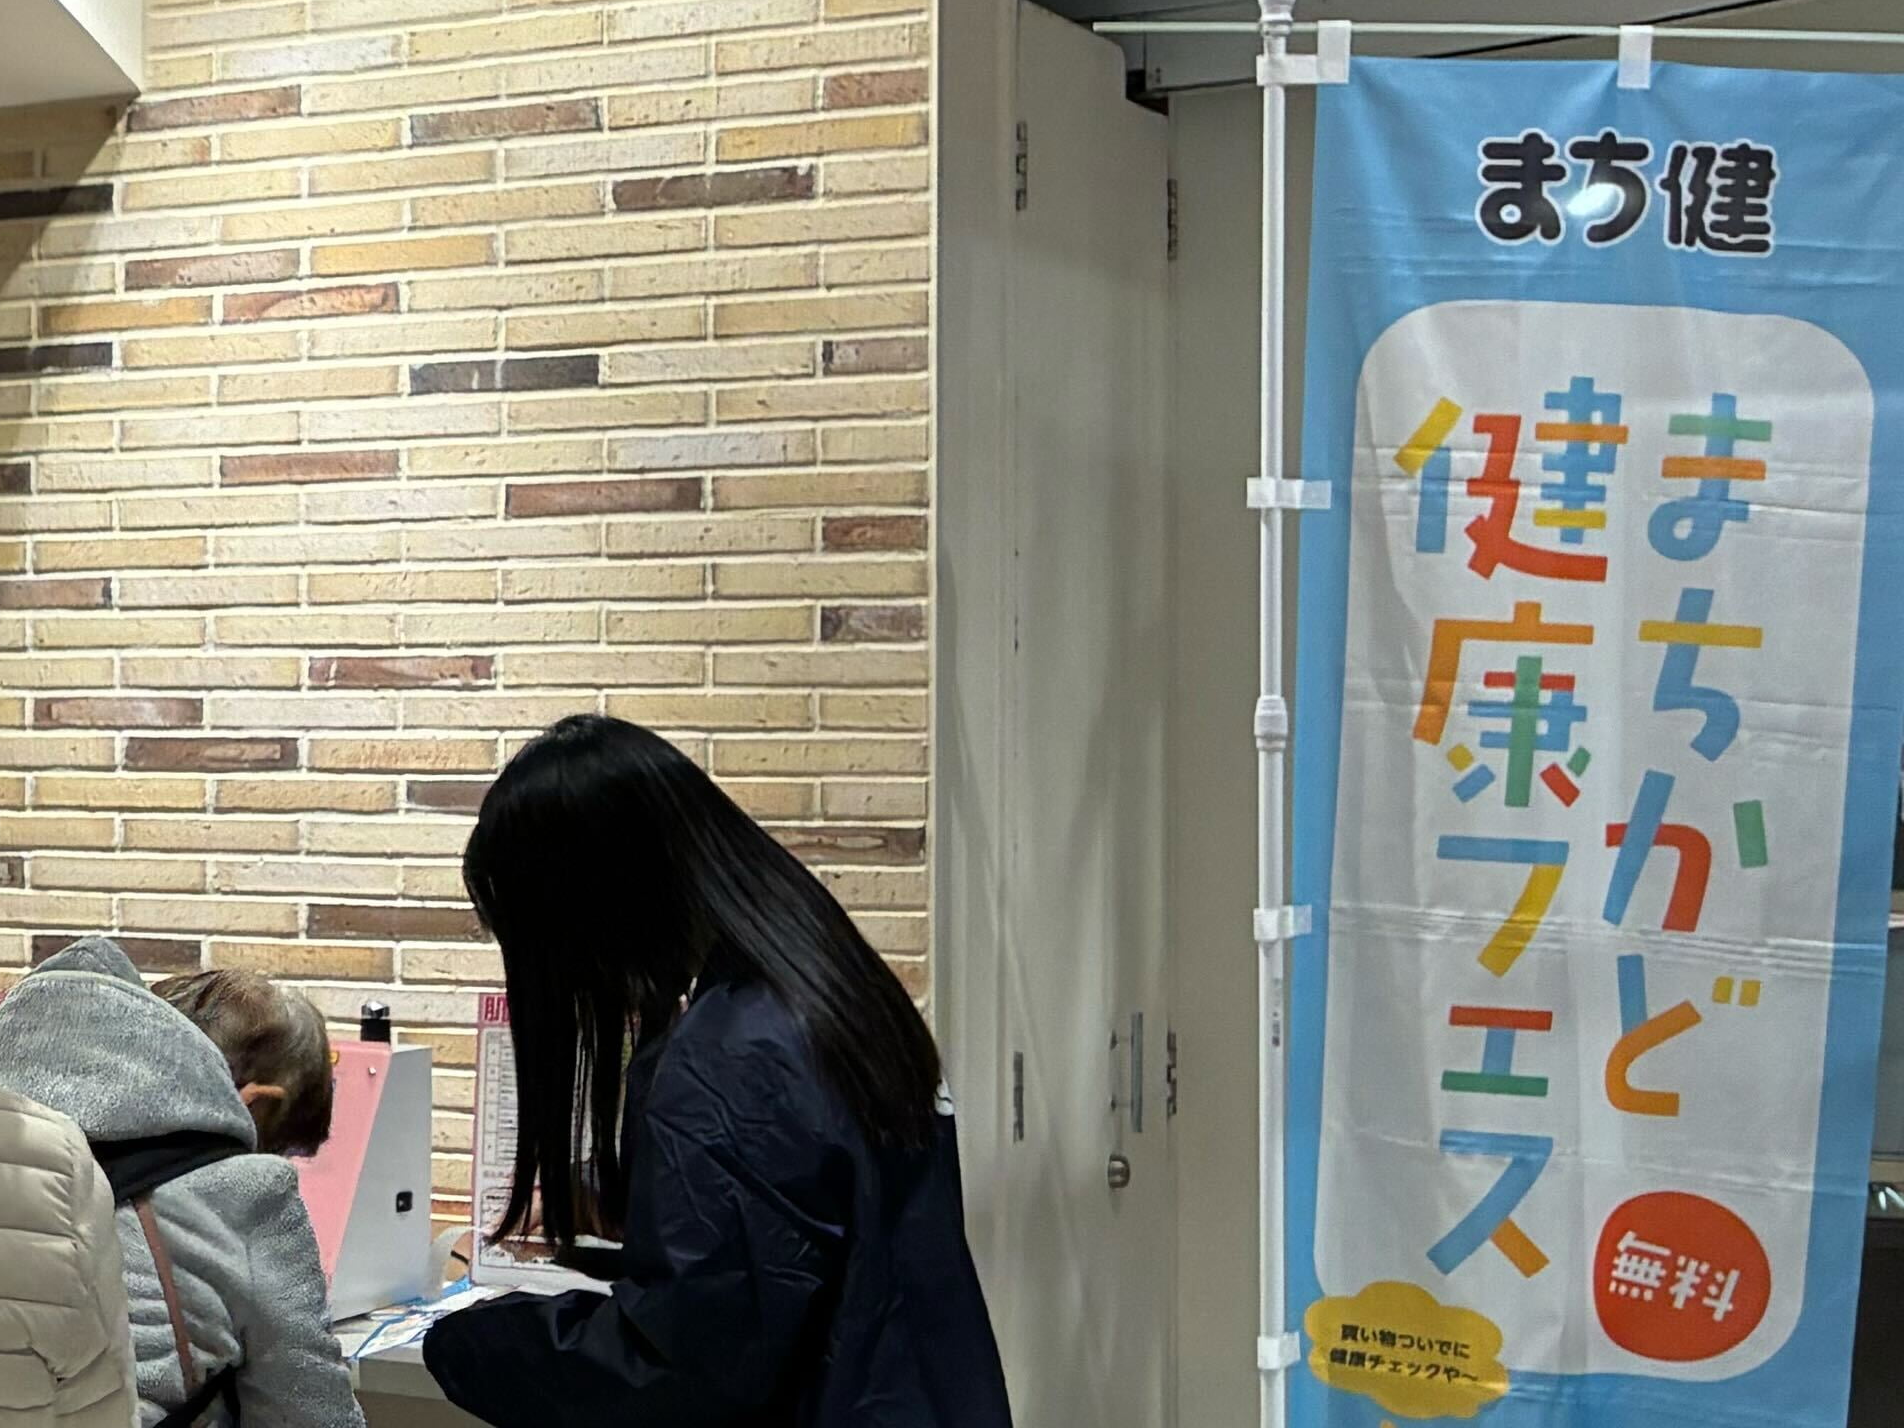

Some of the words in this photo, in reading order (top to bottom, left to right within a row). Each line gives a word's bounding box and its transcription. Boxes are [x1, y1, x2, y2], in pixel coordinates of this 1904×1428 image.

[1478, 130, 1779, 254] まち健
[1603, 391, 1772, 1117] まちかど
[1394, 376, 1629, 1278] 健康フェス
[1607, 1229, 1741, 1322] 無料
[1341, 1324, 1471, 1360] 買い物ついでに
